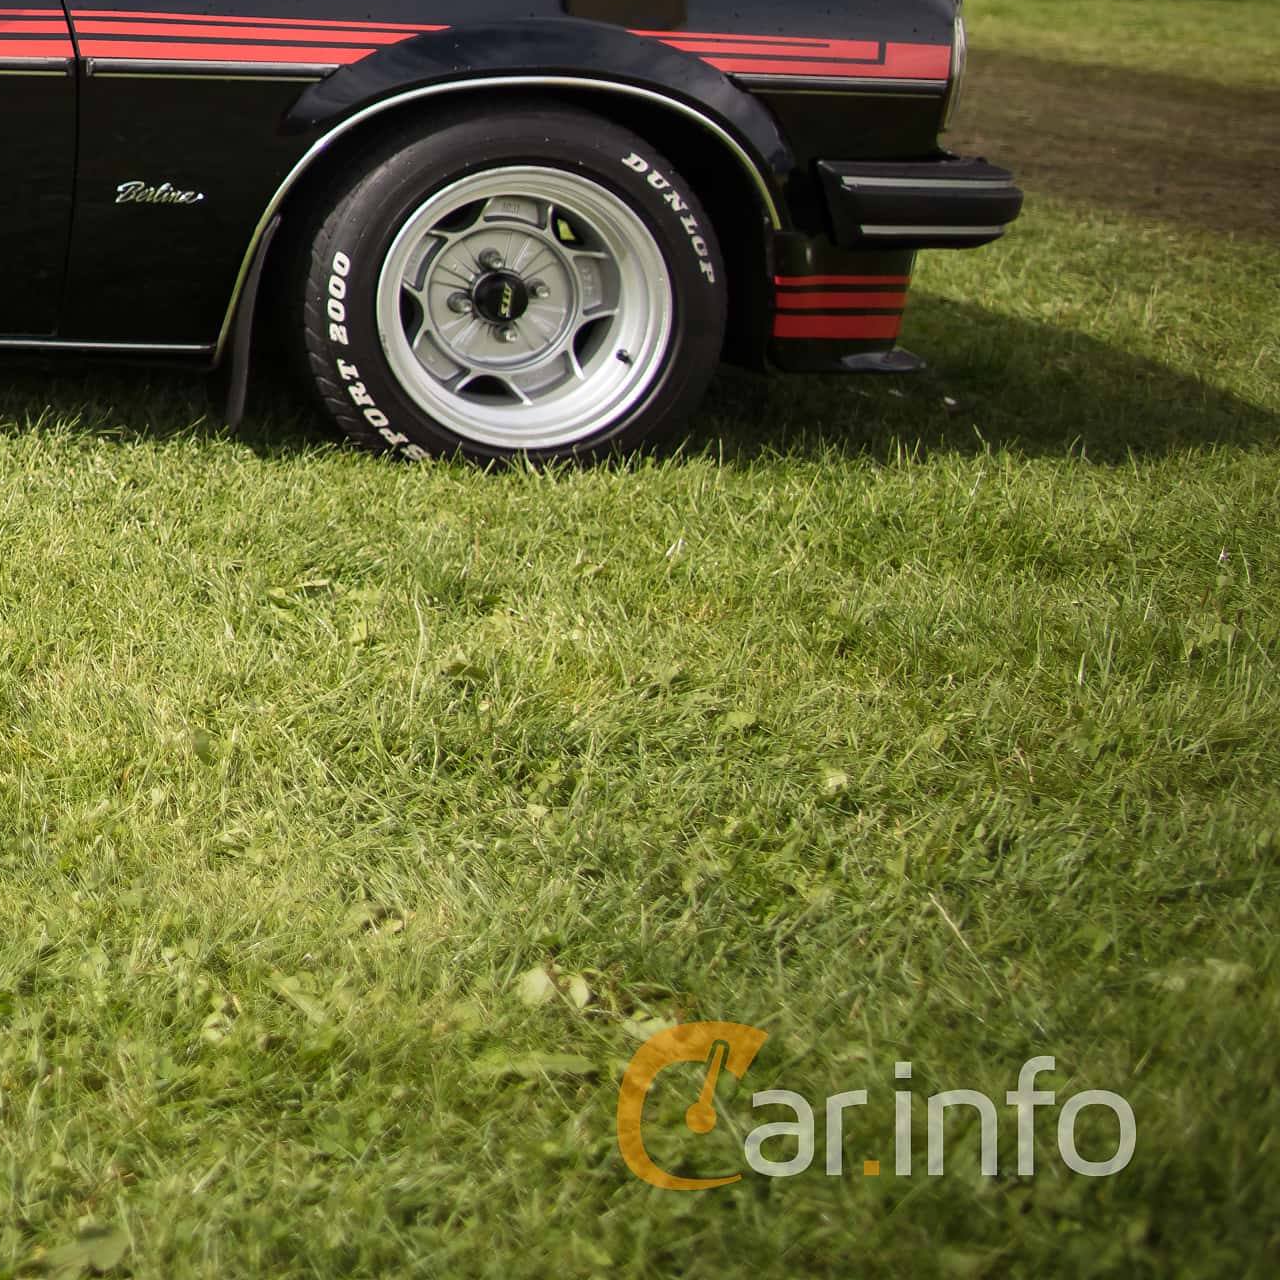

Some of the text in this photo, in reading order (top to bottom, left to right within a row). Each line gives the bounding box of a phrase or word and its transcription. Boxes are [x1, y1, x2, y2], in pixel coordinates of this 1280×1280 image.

[621, 152, 716, 284] DUNLOP
[326, 251, 430, 461] SPORT 2000
